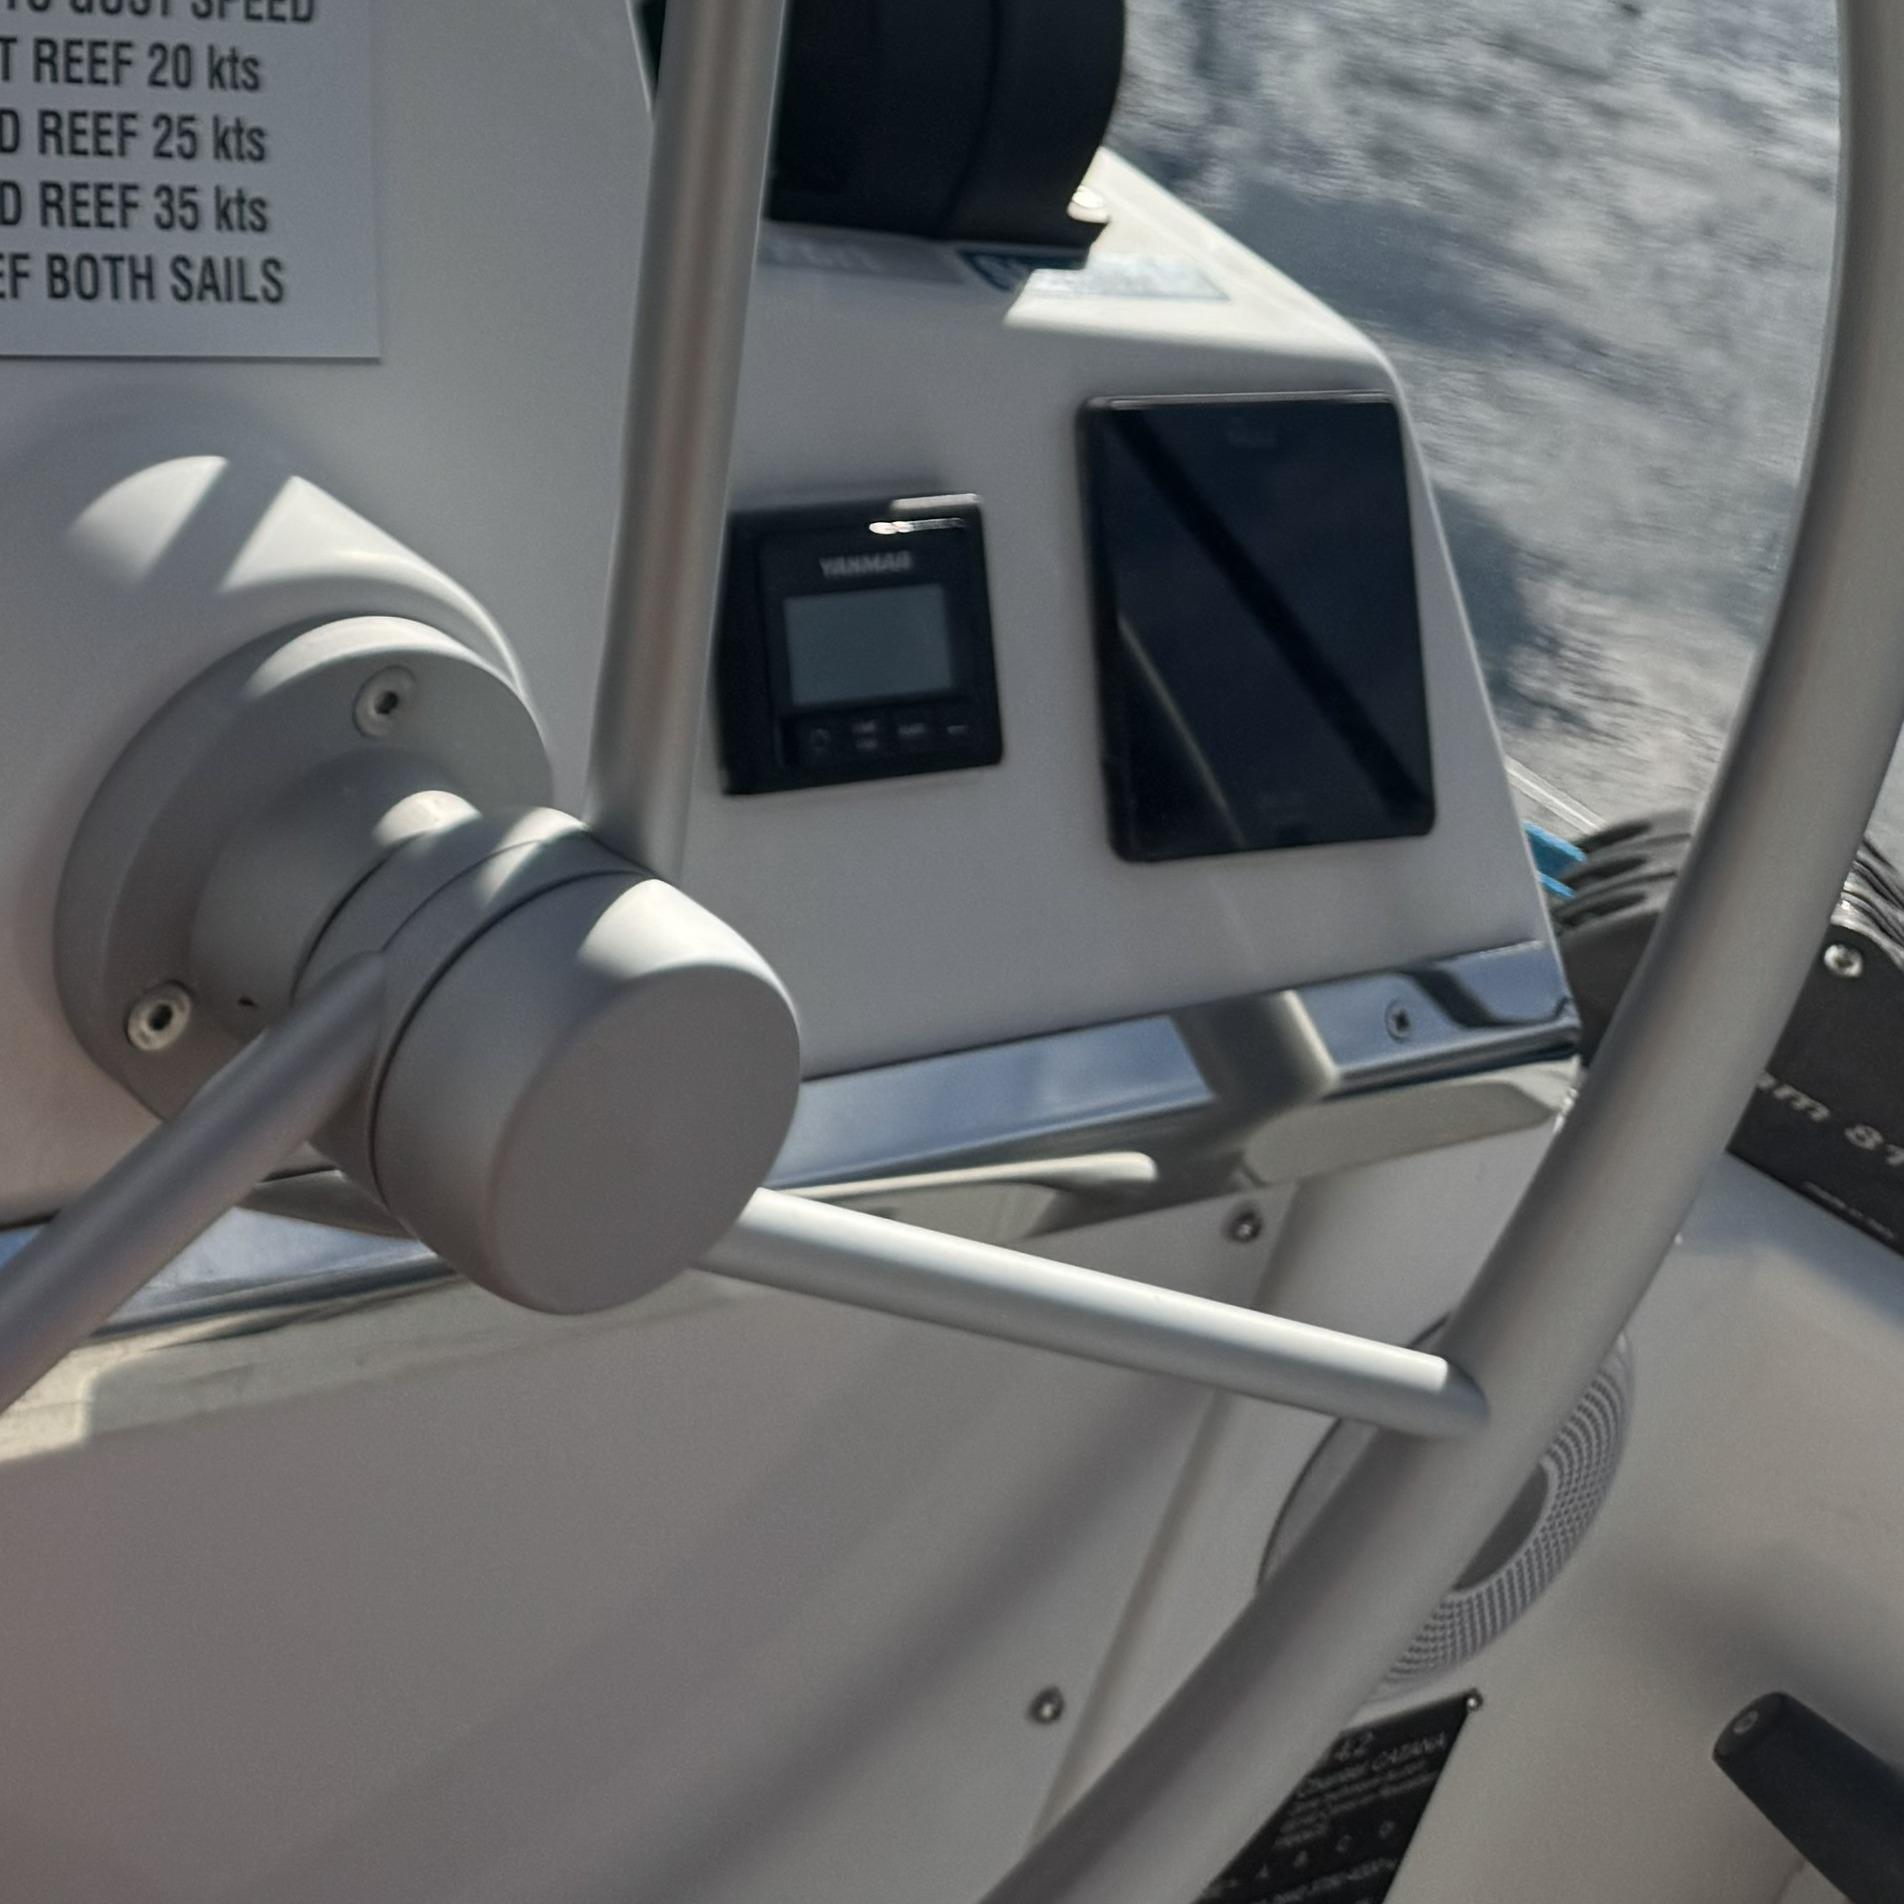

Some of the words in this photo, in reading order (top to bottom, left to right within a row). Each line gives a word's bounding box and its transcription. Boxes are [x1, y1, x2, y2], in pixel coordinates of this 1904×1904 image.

[32, 37, 135, 87] REEF
[147, 42, 194, 90] 20
[207, 45, 263, 93] kts
[37, 110, 140, 159] REEF
[152, 114, 198, 160] 25
[212, 116, 266, 162] kts
[39, 181, 141, 230] REEF
[153, 185, 199, 232] 35
[214, 186, 269, 233] kts
[46, 254, 155, 301] BOTH
[170, 255, 285, 305] SAILS
